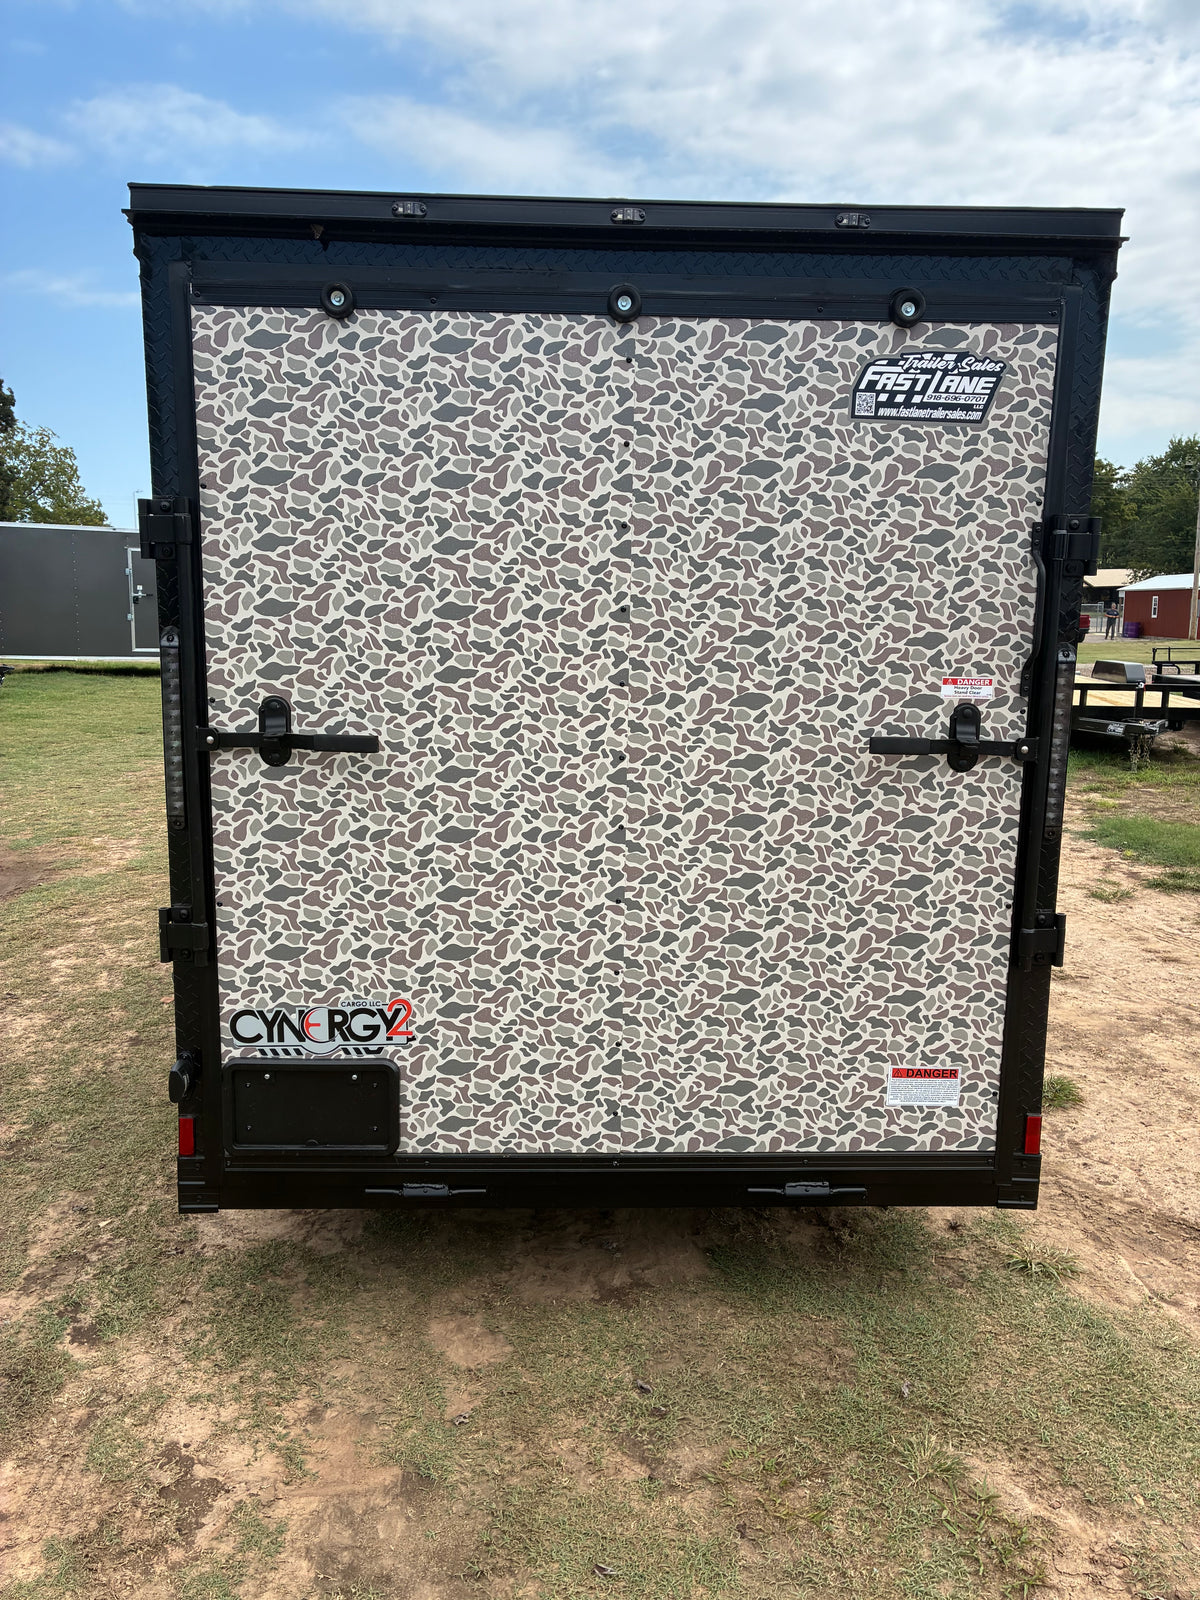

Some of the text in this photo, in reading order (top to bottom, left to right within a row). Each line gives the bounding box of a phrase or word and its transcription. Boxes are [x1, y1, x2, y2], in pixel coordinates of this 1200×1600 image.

[902, 355, 1004, 373] Trailer Sales
[926, 393, 986, 403] 918-696-0701
[877, 405, 983, 420] www.fastlanetrailersales.com
[906, 1068, 957, 1078] DANGER
